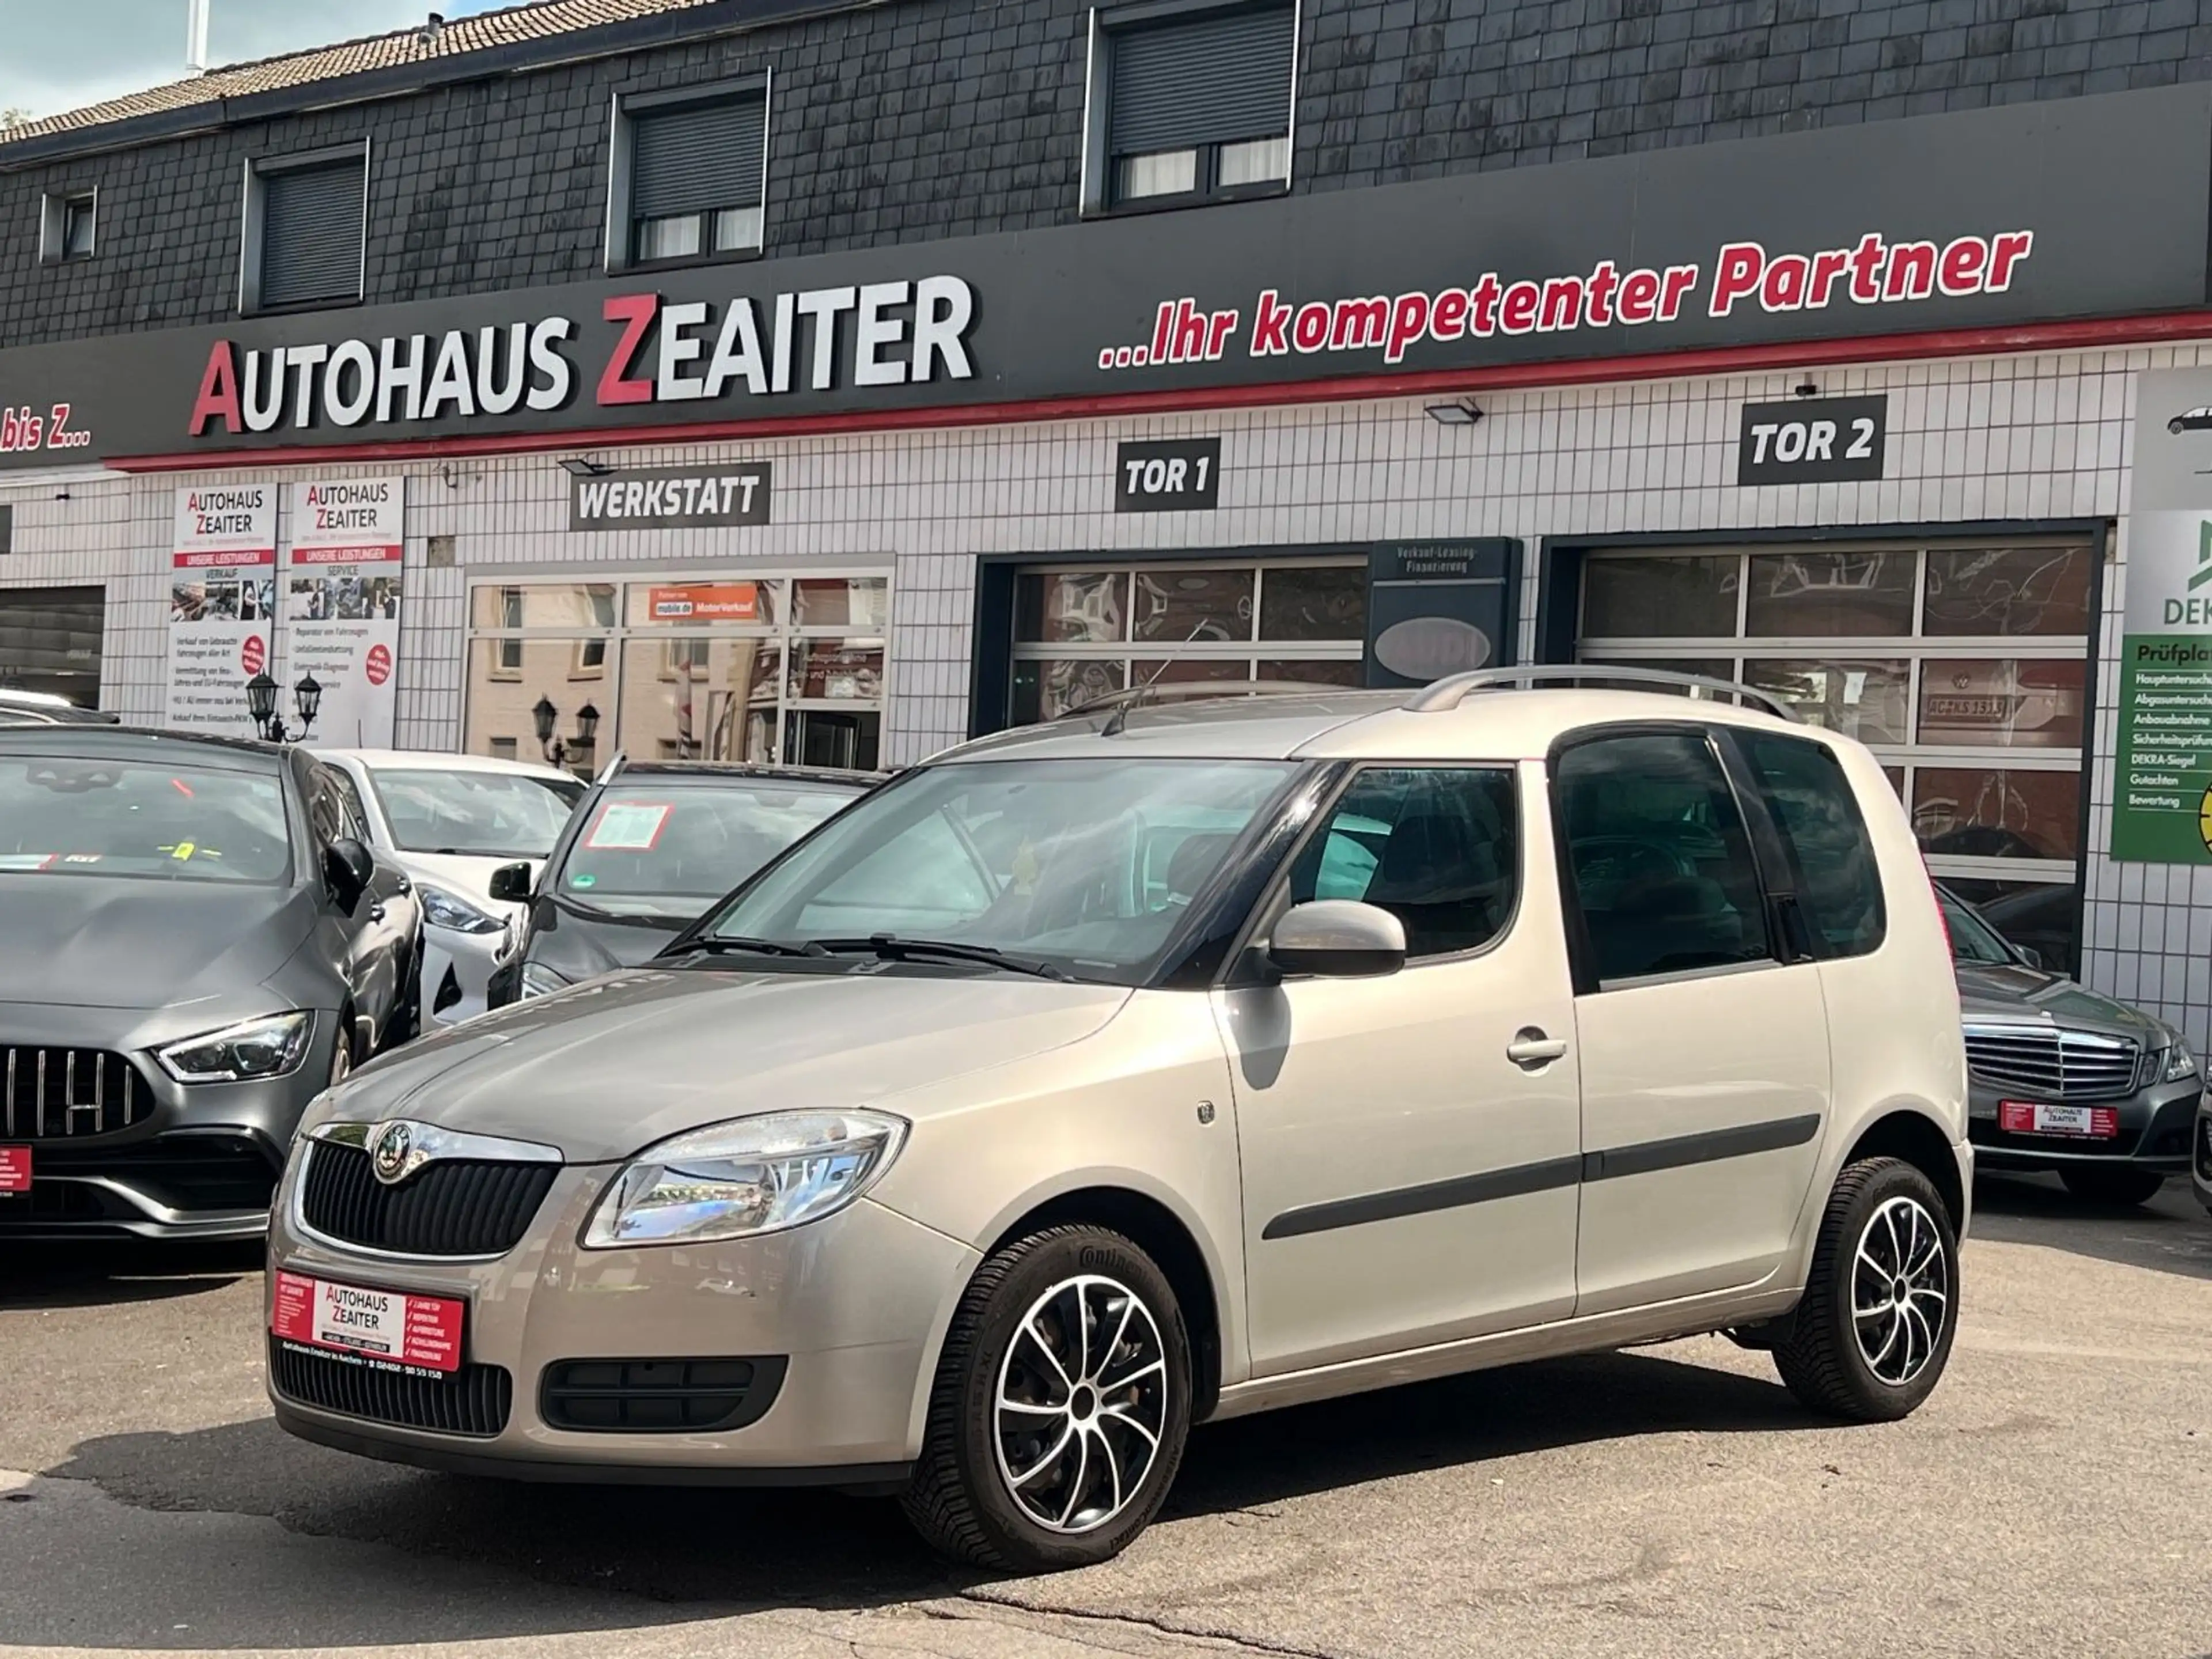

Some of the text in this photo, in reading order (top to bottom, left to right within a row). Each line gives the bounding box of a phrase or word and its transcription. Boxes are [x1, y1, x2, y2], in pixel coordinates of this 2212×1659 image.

[1099, 231, 2033, 369] ...Ihr kompetenter Partner
[188, 275, 972, 435] AUTOHAUS ZEAITER
[0, 406, 43, 452] bis
[1751, 418, 1874, 464] TOR 2
[1126, 456, 1209, 494] TOR 1
[188, 490, 263, 512] AUTOHAUS
[307, 483, 388, 506] AUTOHAUS
[579, 476, 759, 518] WERKSTATT
[196, 514, 252, 535] ZEAITER
[316, 509, 377, 529] ZEAITER
[306, 548, 386, 562] UNSERE LEISTUNGEN
[327, 565, 359, 576] SERVICE
[2130, 774, 2179, 785] Gutachten
[2129, 794, 2180, 808] Bewertung
[326, 1285, 388, 1312] AUTOHAUS
[332, 1305, 379, 1330] ZEAITER
